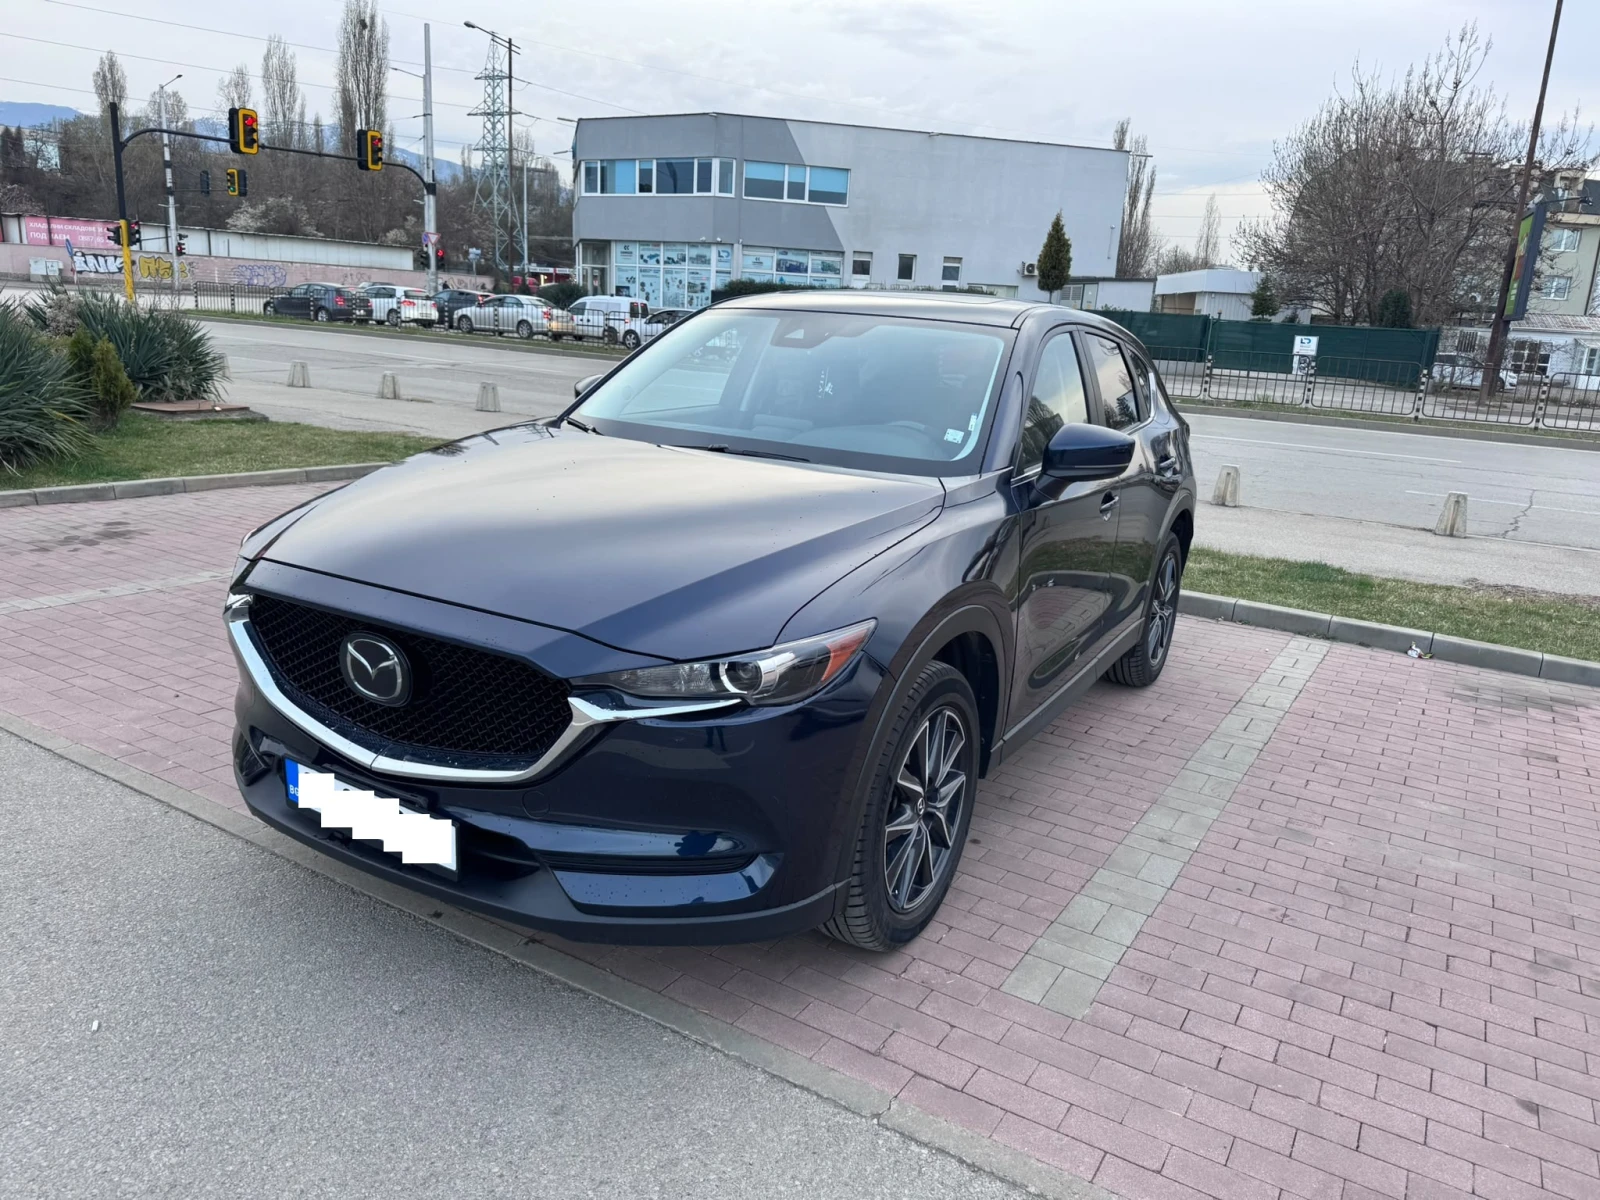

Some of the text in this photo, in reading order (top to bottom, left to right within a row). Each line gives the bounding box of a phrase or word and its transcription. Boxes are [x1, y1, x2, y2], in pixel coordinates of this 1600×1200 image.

[29, 222, 64, 230] ХЛАДЛНИ
[30, 232, 47, 240] ПОД
[289, 784, 299, 797] BG
